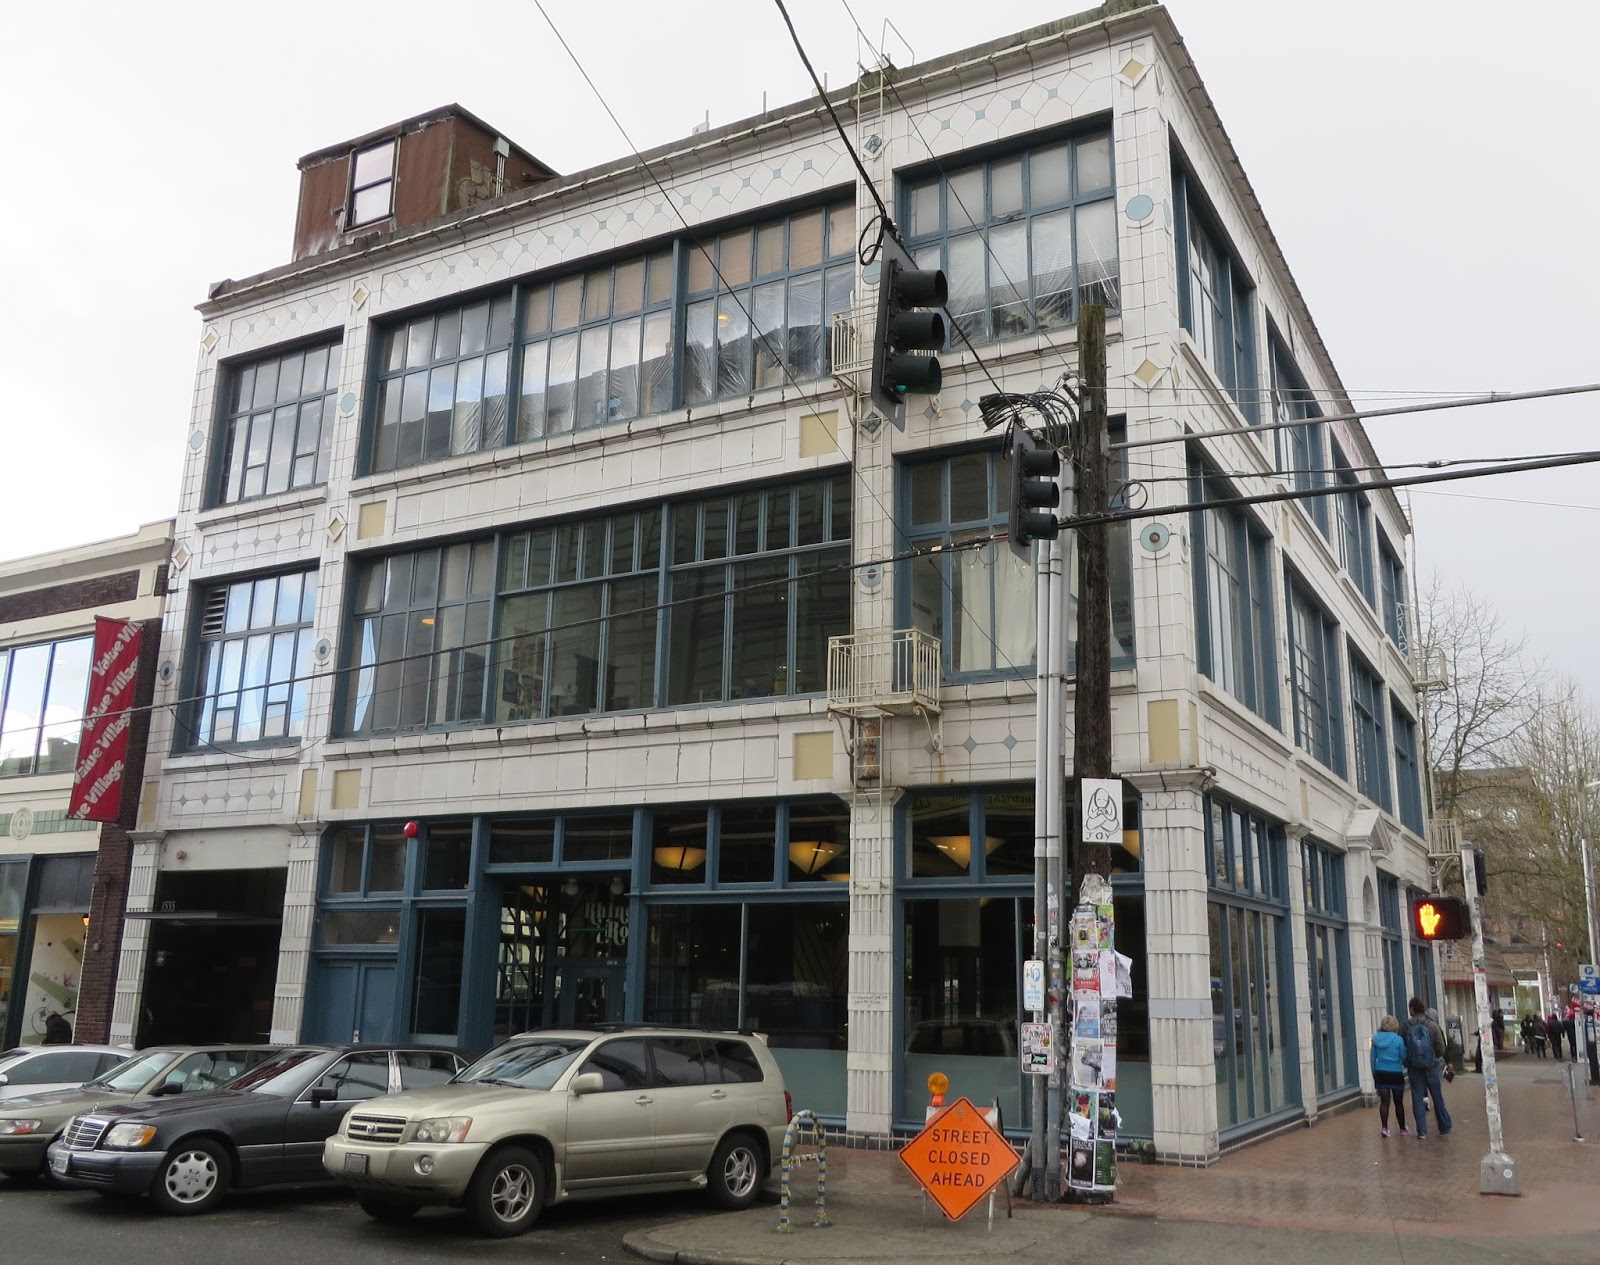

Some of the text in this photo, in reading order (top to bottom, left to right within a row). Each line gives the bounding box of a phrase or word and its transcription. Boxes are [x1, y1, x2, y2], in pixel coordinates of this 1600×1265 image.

[92, 640, 124, 676] Value
[73, 759, 124, 819] ue Village
[1085, 831, 1110, 842] JOY
[931, 1128, 990, 1145] STREET
[928, 1149, 991, 1166] CLOSED
[930, 1171, 985, 1188] AHEAD
